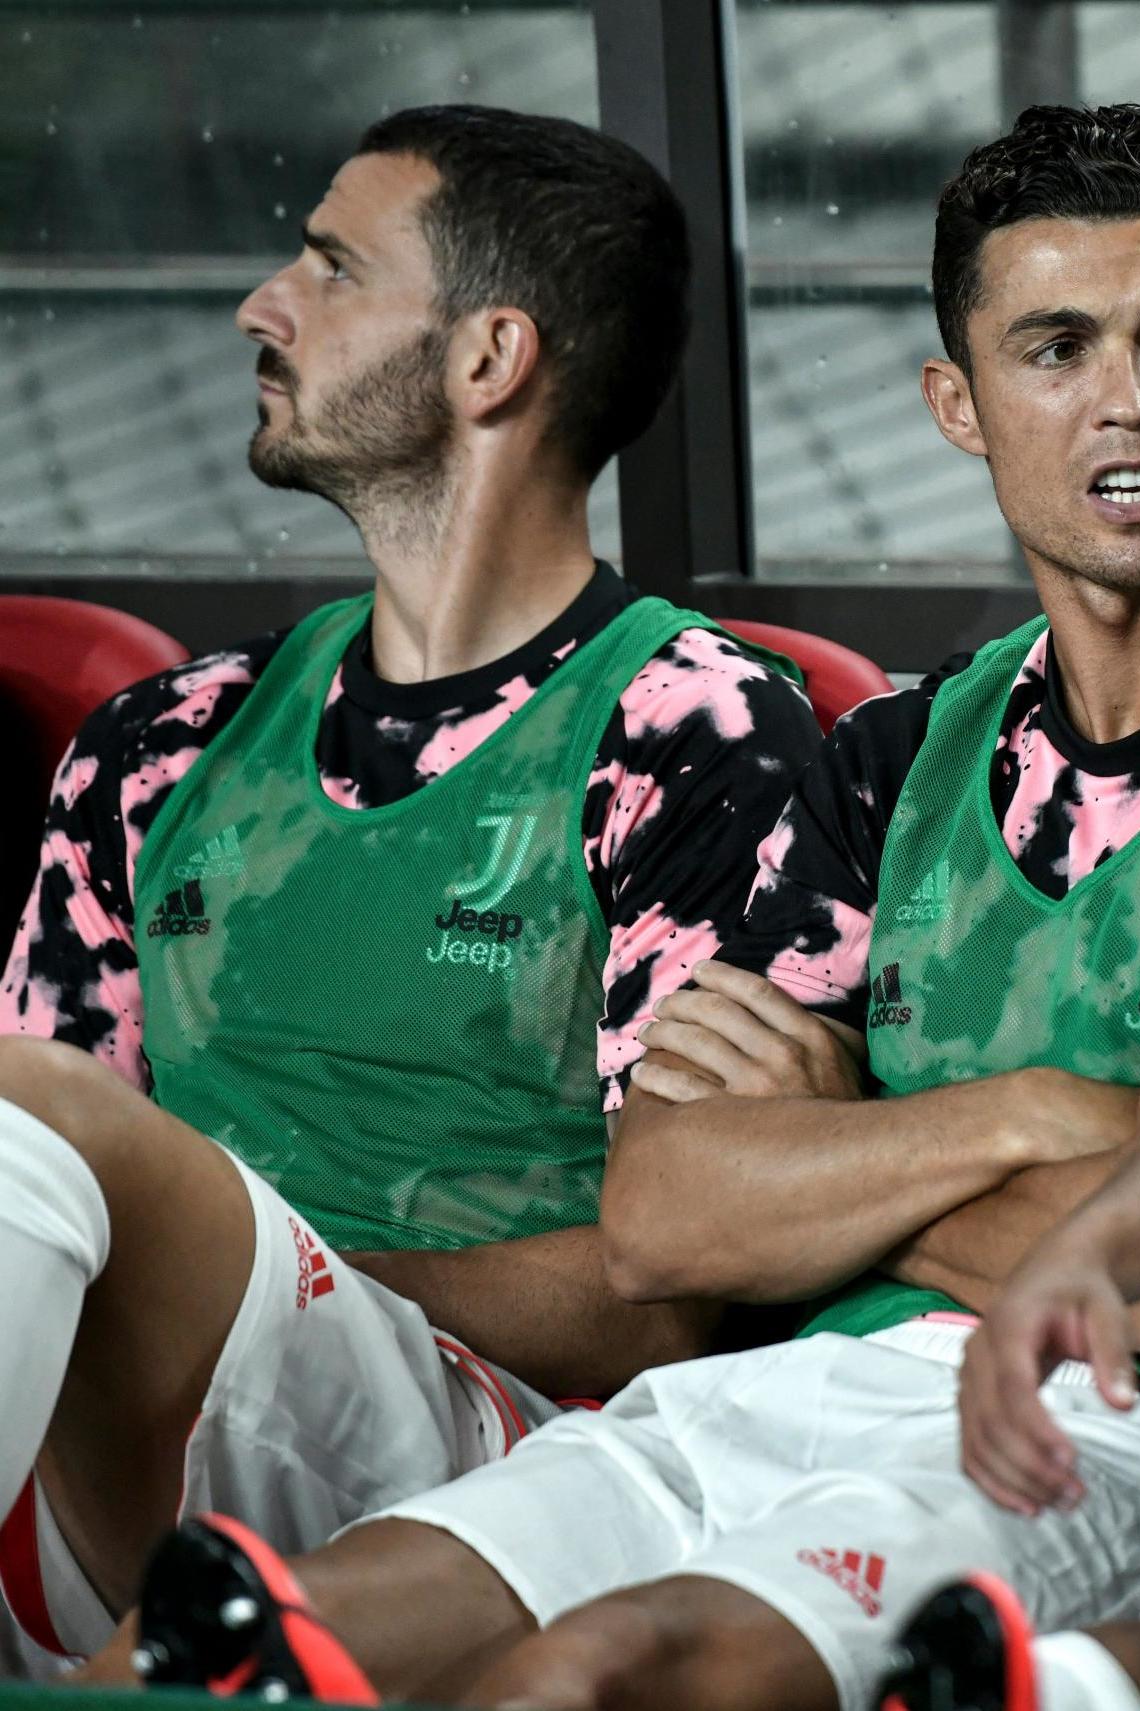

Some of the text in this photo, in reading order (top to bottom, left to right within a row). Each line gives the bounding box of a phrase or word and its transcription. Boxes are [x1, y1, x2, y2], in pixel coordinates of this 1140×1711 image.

[147, 916, 211, 938] adidas
[435, 899, 523, 944] Jeep
[426, 930, 513, 972] Jeep
[287, 1216, 312, 1310] adidas
[796, 1549, 882, 1618] adidas
